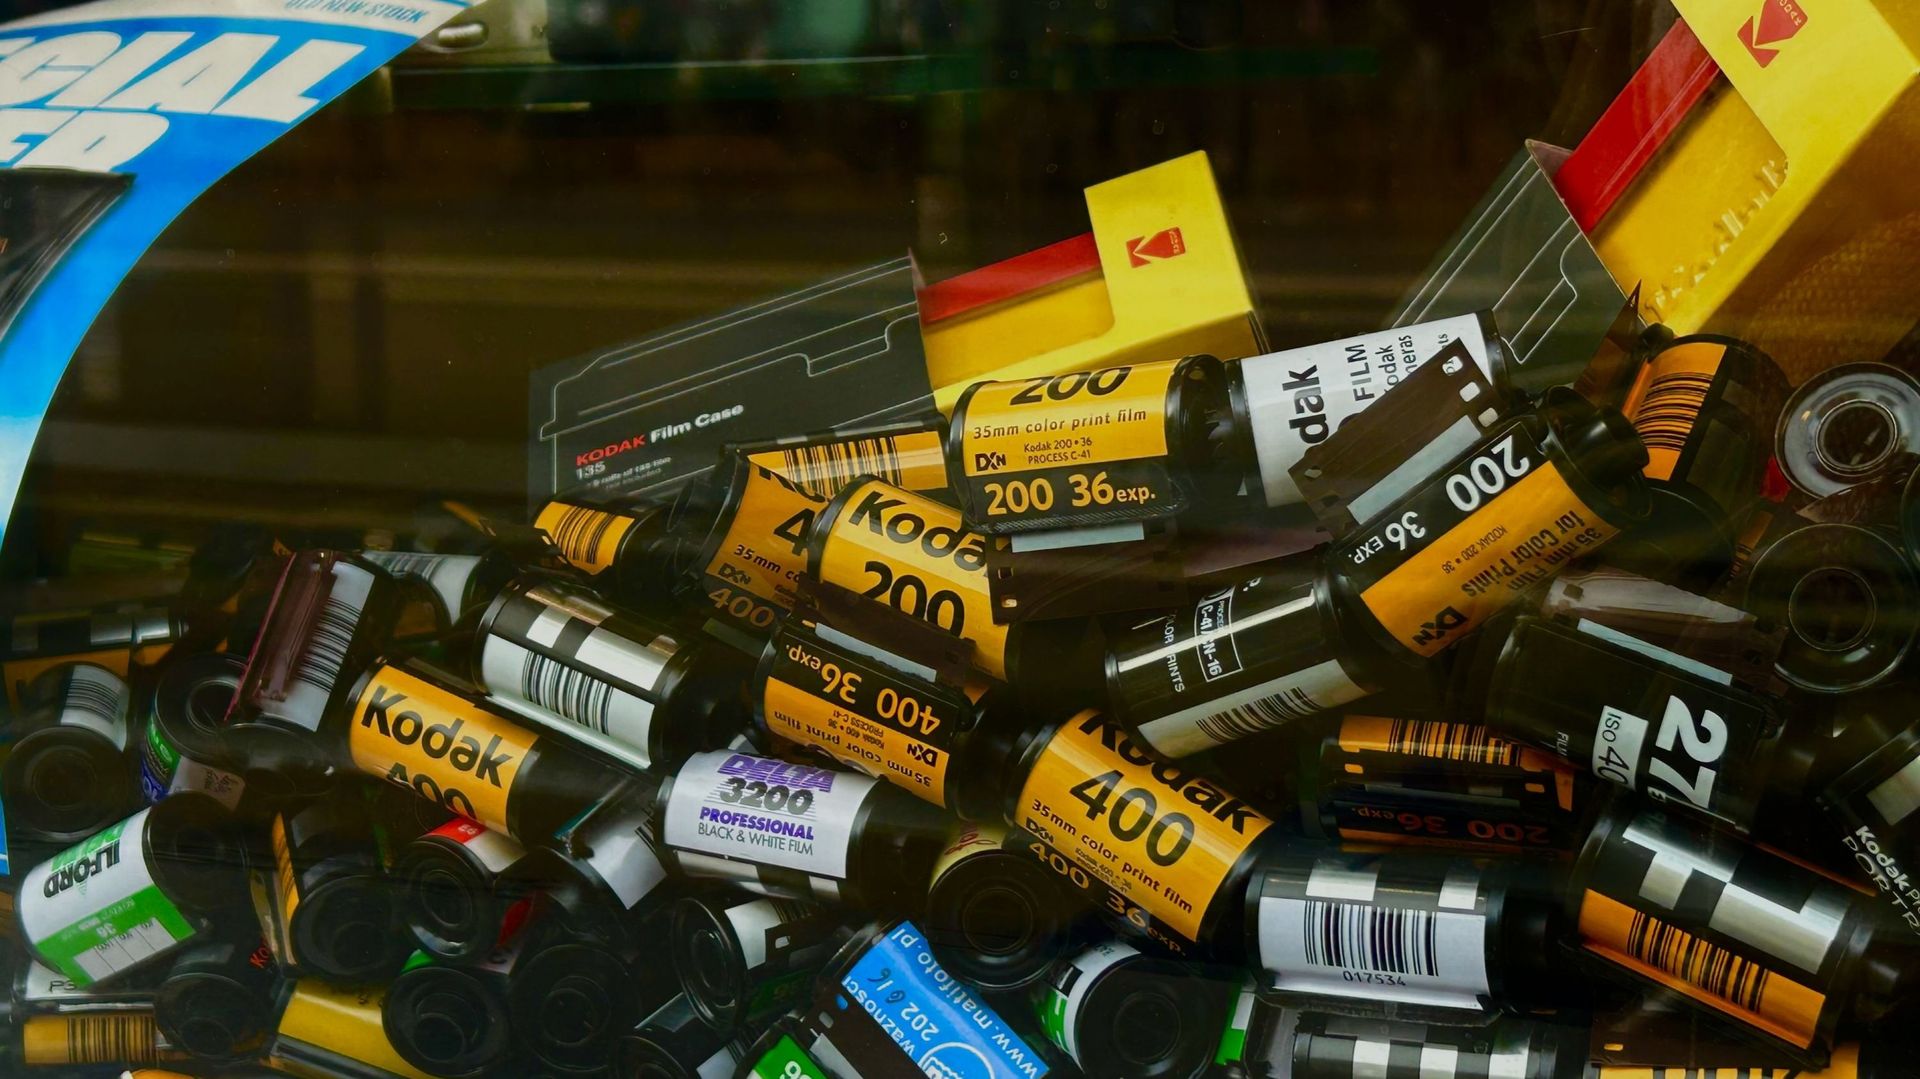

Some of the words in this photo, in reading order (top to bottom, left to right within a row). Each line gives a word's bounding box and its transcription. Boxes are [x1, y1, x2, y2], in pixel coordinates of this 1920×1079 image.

[363, 4, 428, 23] STOCK
[1778, 0, 1801, 26] ODAK
[1009, 366, 1132, 406] 200
[1345, 344, 1375, 402] FILM
[1375, 345, 1399, 392] odak
[973, 425, 1019, 440] 35mm
[1026, 418, 1065, 434] color
[1072, 412, 1110, 430] print
[1118, 409, 1146, 423] film
[1282, 365, 1329, 444] dak
[576, 434, 646, 466] KODAK
[650, 421, 692, 443] Film
[695, 404, 744, 428] Case
[1024, 441, 1051, 453] Kodak
[1054, 438, 1072, 450] 200
[1080, 436, 1092, 446] 36
[576, 460, 606, 480] 135
[1028, 452, 1069, 465] PROCESS
[1071, 450, 1091, 461] C-41
[1446, 434, 1531, 512] 200
[984, 478, 1054, 516] 200
[848, 490, 987, 578] Koda
[1385, 510, 1427, 551] 36
[1480, 525, 1508, 549] KODAK
[1555, 510, 1586, 533] for
[1461, 542, 1481, 562] 200
[1511, 529, 1560, 564] Color
[1461, 557, 1515, 598] Prints
[708, 588, 775, 628] 400
[865, 560, 965, 639] 200
[1167, 653, 1185, 693] RINTS
[774, 711, 802, 730] film
[876, 688, 941, 735] 400
[1602, 712, 1622, 743] ISO
[361, 685, 513, 788] Kodak
[805, 724, 841, 744] print
[846, 743, 882, 763] color
[1649, 694, 1728, 809] 27
[717, 753, 838, 793] DELTA
[720, 776, 814, 815] 3200
[699, 806, 814, 840] PROFESSIONAL
[1069, 769, 1195, 867] 400
[1467, 819, 1551, 844] 200
[698, 823, 733, 841] BLACK
[736, 830, 745, 843] &
[749, 831, 786, 850] WHITE
[788, 839, 813, 856] FILM
[1855, 825, 1911, 891] Kodak
[43, 840, 121, 899] ILFORD
[1029, 842, 1090, 890] 400
[1081, 834, 1119, 863] color
[1122, 862, 1161, 892] print
[1164, 887, 1193, 914] film
[1842, 836, 1920, 936] PORTR
[1342, 970, 1407, 987] 017534
[892, 927, 1038, 1079] www.matifoto.pl
